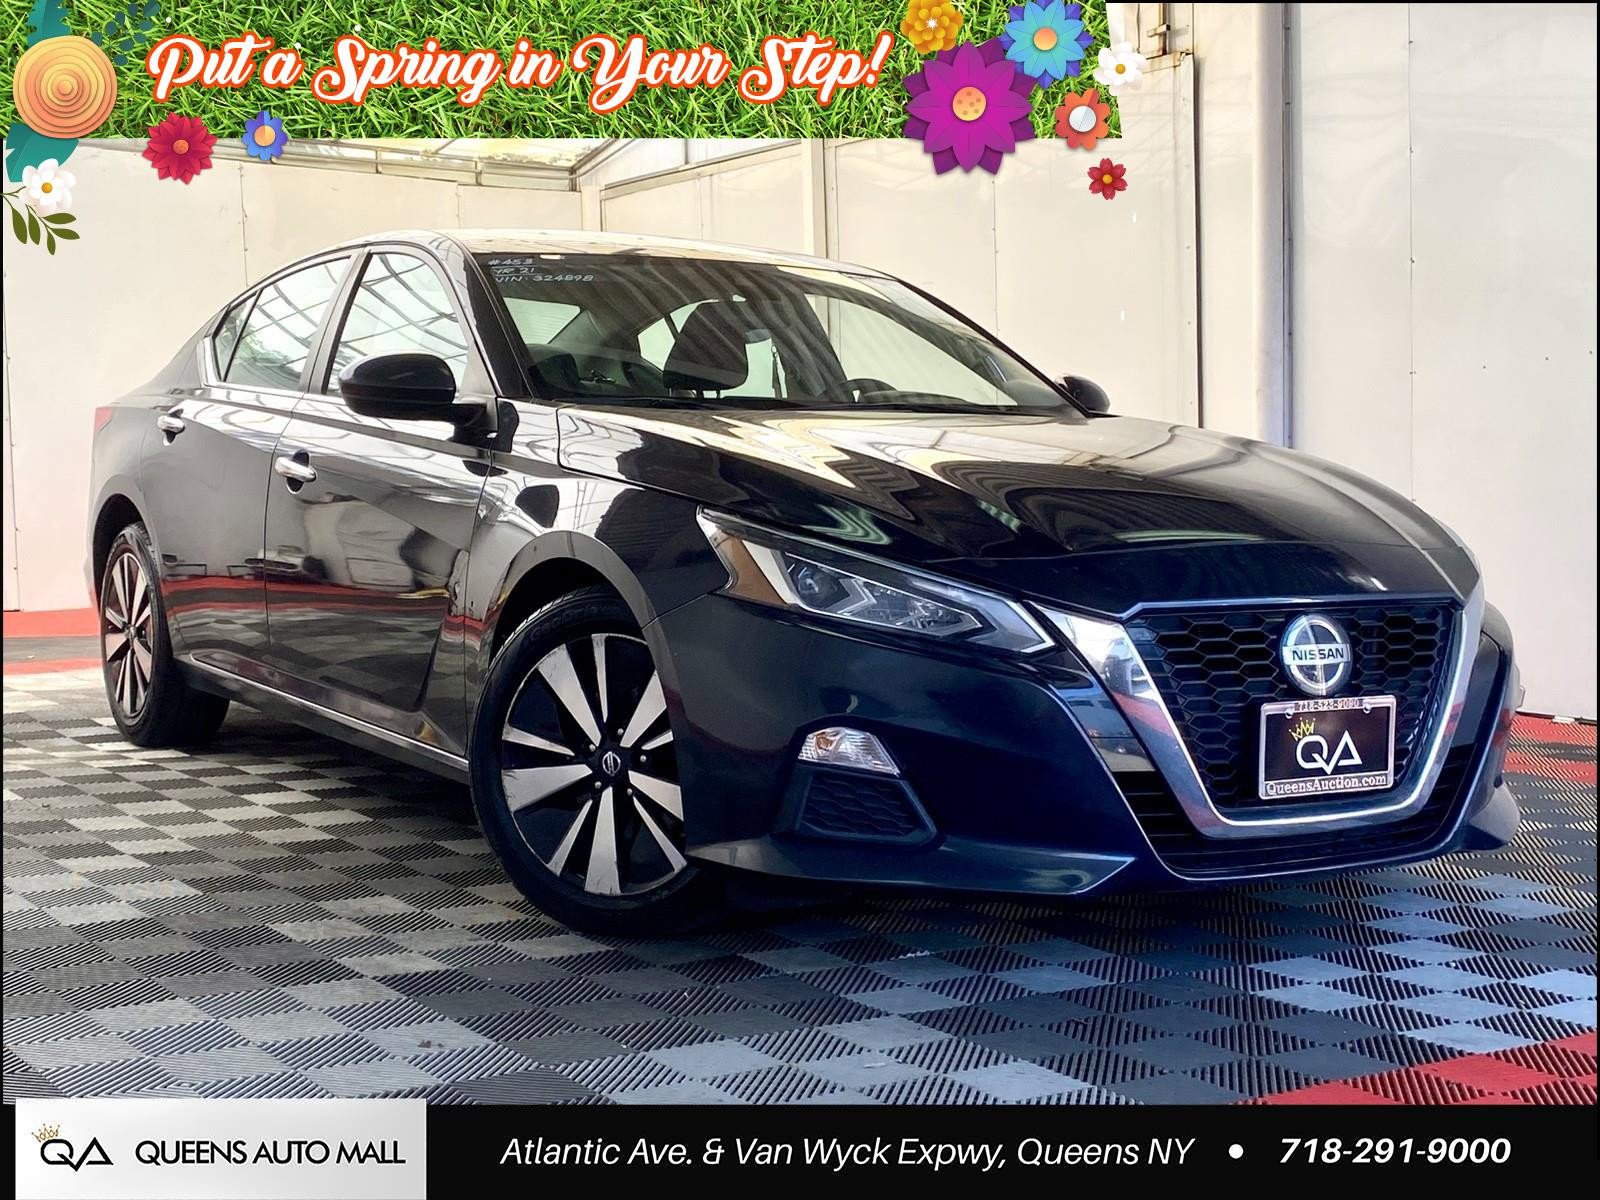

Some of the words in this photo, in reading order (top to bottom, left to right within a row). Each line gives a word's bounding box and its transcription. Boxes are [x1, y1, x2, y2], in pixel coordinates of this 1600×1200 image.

[1292, 648, 1344, 661] NISSAN
[1296, 730, 1362, 775] QA
[1266, 774, 1387, 795] QueensAuction.com
